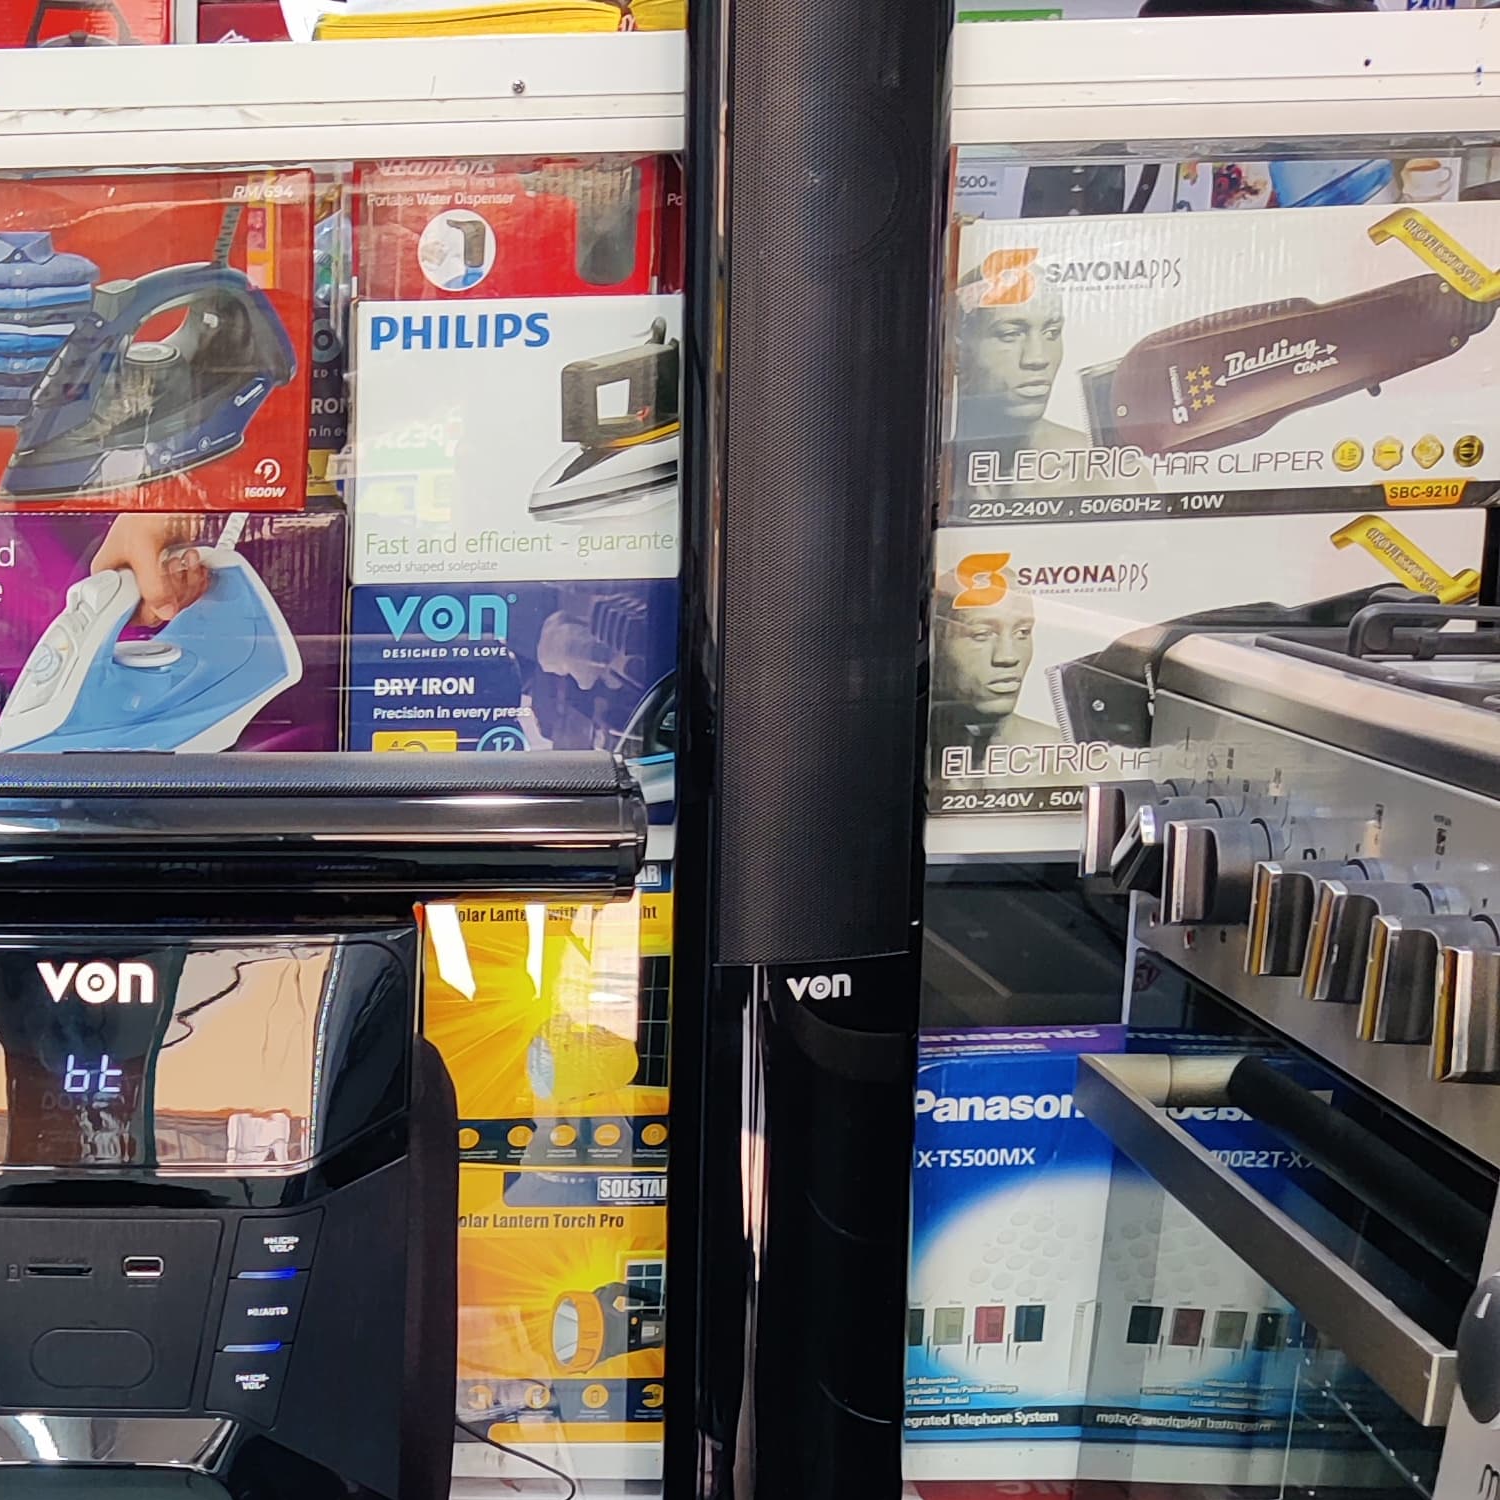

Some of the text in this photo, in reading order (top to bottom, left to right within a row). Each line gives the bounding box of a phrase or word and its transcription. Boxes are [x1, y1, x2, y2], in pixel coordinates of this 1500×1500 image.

[956, 175, 988, 189] 500
[233, 184, 294, 199] RM/694
[416, 193, 452, 206] Water
[454, 192, 515, 206] Dispenser
[370, 312, 550, 351] PHILIPS
[1224, 338, 1320, 377] Balding
[968, 447, 1324, 485] ELECTRIC HAIR CLIPPER
[243, 486, 286, 498] 1600W
[1388, 484, 1459, 501] SBC-9210
[1180, 495, 1224, 511] 10W
[366, 533, 409, 555] Fast
[415, 532, 457, 554] and
[465, 530, 552, 553] efficient
[366, 559, 498, 574] Speed shaped soleplate
[383, 647, 507, 658] DESIGNED TO LOVE
[373, 677, 475, 696] DRY IRON
[373, 706, 532, 721] Precision in every press
[943, 744, 1108, 778] ELECTRIC
[459, 908, 485, 923] olar
[63, 1054, 123, 1093] bt
[917, 1148, 1036, 1168] X-TS500MX
[493, 1213, 549, 1228] Lantern
[553, 1213, 596, 1228] Torch
[599, 1213, 625, 1228] Pro
[905, 1411, 1059, 1429] egrated Telephone System
